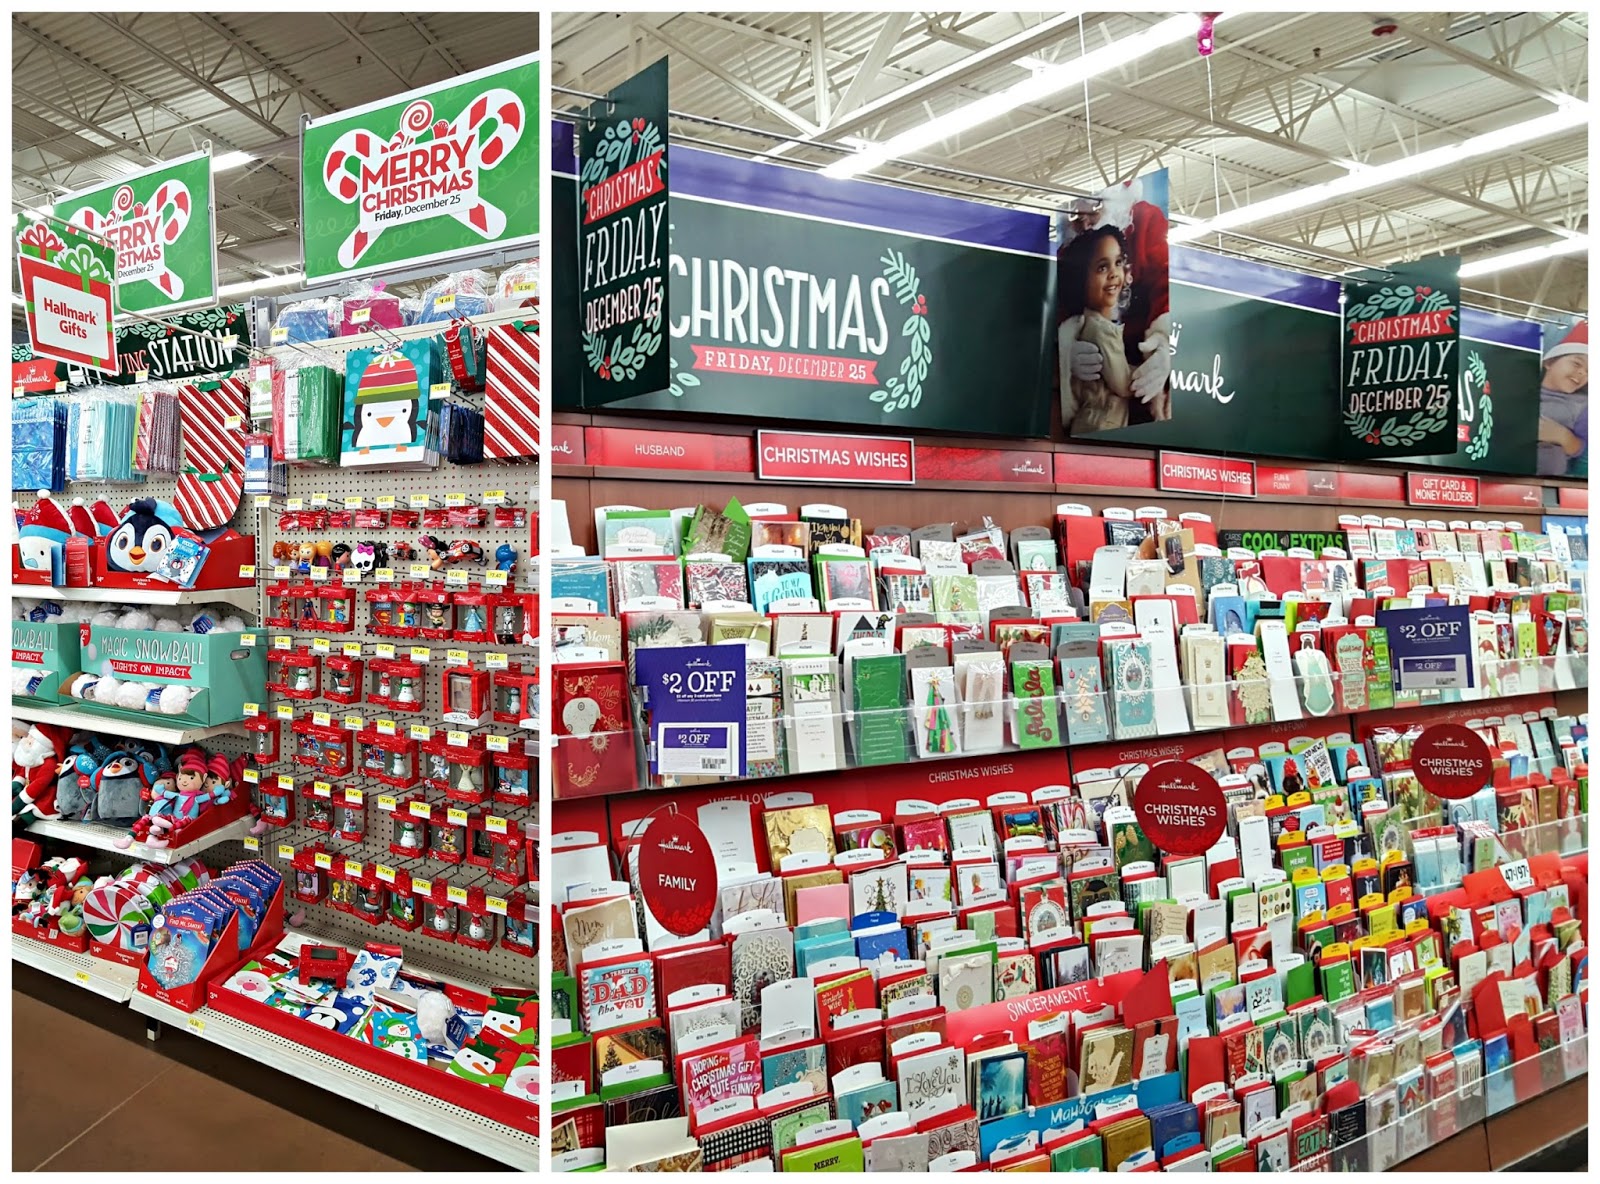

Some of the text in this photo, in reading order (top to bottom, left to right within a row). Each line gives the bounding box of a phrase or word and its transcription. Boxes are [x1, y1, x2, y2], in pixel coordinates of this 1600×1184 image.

[362, 133, 476, 193] MERRY
[362, 169, 474, 213] CHRISTMAS
[588, 159, 654, 220] CHRISTMAS
[374, 194, 461, 222] Friday, December 25
[105, 215, 161, 252] ERRY
[583, 201, 667, 292] FRIDAY,
[117, 243, 161, 270] STMAS
[118, 263, 154, 279] December 25
[43, 297, 97, 326] Hallmark
[586, 276, 662, 335] DECEMBER 25
[669, 253, 890, 356] CHRISTMAS
[59, 320, 87, 339] Gifts
[1357, 313, 1442, 343] CHRISTMAS
[148, 327, 233, 376] STATION
[704, 350, 867, 380] FRIDAY, DECEMBER 25
[1347, 340, 1456, 387] FRIDAY,
[15, 372, 51, 387] Hallmark
[1170, 354, 1235, 404] mark
[1350, 386, 1423, 414] DECEMBER
[1425, 384, 1450, 410] 25
[634, 444, 685, 457] HUSBAND
[763, 445, 908, 468] CHRISTMAS WISHES
[1011, 464, 1046, 477] Hallmark
[1163, 464, 1252, 485] CHRISTMAS WISHES
[1273, 473, 1284, 481] FUN
[1273, 481, 1291, 489] FUNNY
[1422, 478, 1467, 491] GIFT CARD &
[1416, 490, 1473, 502] MONEY HOLDERS
[1242, 532, 1282, 550] COOL
[1290, 533, 1343, 550] EXTRAS
[586, 631, 611, 642] Mom
[1399, 621, 1462, 638] $2 OFF
[12, 627, 54, 651] OWBALL
[15, 653, 41, 662] IMPACT
[101, 635, 205, 665] MAGIC SNOWBALL
[112, 661, 188, 677] LIGHTS ON IMPACT
[685, 659, 712, 669] Hallmark
[1424, 662, 1443, 670] OFF
[662, 671, 736, 693] $2 OFF
[678, 733, 711, 744] $2 OFF
[1432, 740, 1468, 749] Hallmark
[1118, 745, 1185, 761] CHRISTMAS WISHES
[1419, 758, 1483, 768] CHRISTMAS
[1430, 767, 1474, 776] WISHES
[928, 764, 1014, 784] CHRISTMAS WISHES
[1157, 782, 1200, 793] Hallmark
[1144, 803, 1217, 818] CHRISTMAS
[1156, 814, 1206, 827] WISHES
[657, 839, 694, 854] Hallmark
[658, 873, 697, 892] FAMILY
[591, 974, 649, 1006] DAD
[614, 996, 645, 1010] YOU
[1006, 984, 1091, 1022] SINCERAMENTE
[710, 1079, 730, 1098] CUTE
[731, 1082, 760, 1096] FUNNY?
[813, 1155, 841, 1171] MERRY.
